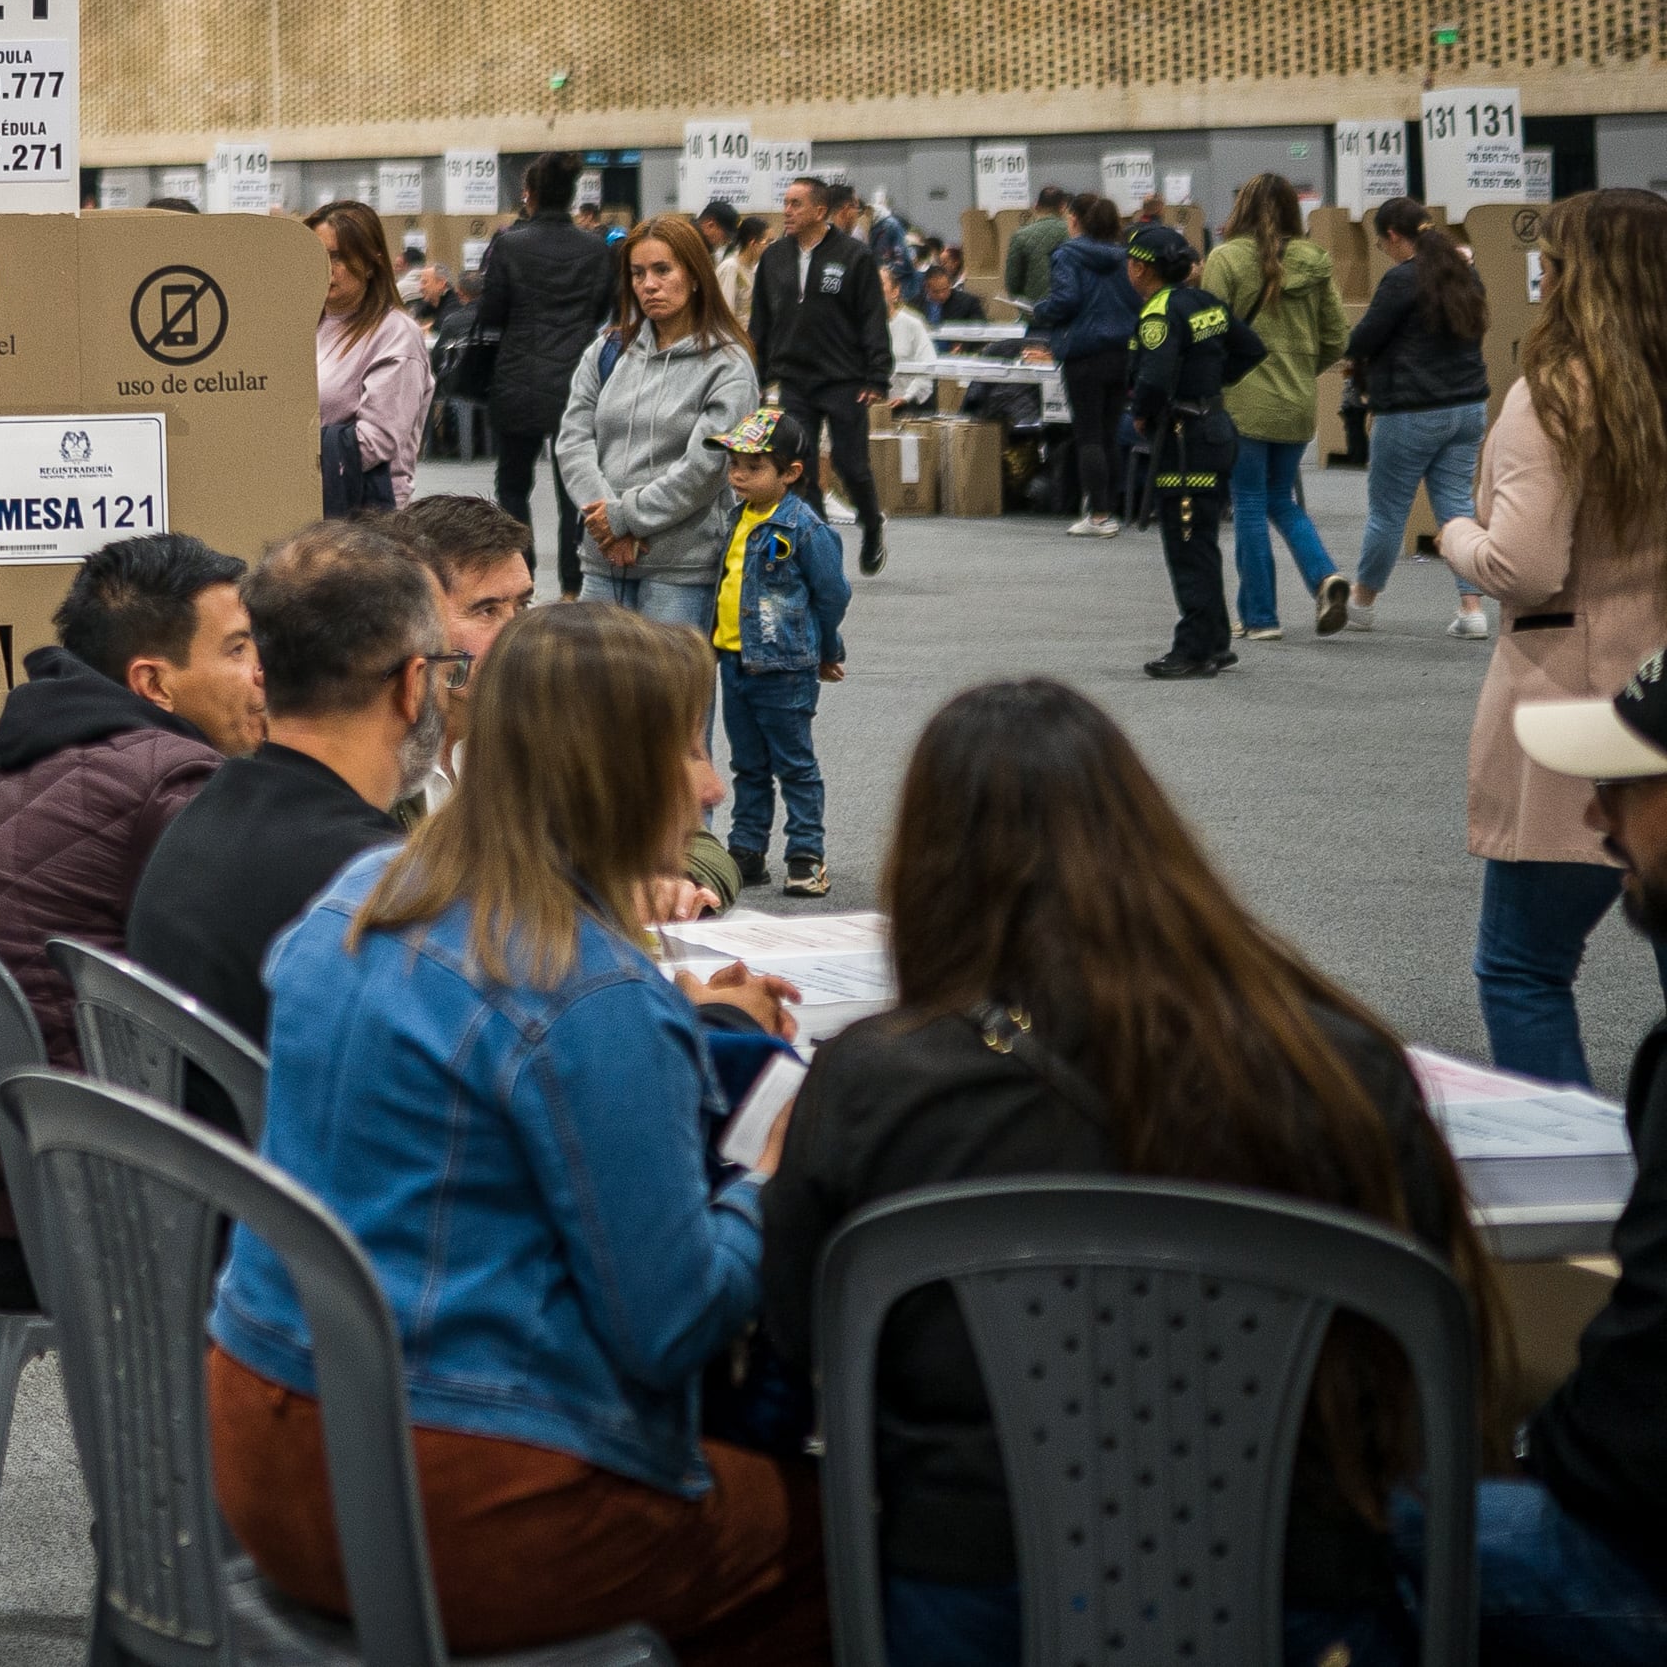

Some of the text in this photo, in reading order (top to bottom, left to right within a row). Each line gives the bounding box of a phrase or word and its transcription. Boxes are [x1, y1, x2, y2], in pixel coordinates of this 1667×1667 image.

[1425, 106, 1457, 140] 131
[1466, 104, 1515, 137] 131
[708, 134, 748, 159] 140
[1366, 131, 1401, 155] 141
[233, 153, 267, 175] 149
[775, 150, 808, 171] 150
[117, 371, 269, 398] uso de celular
[92, 495, 154, 529] 121
